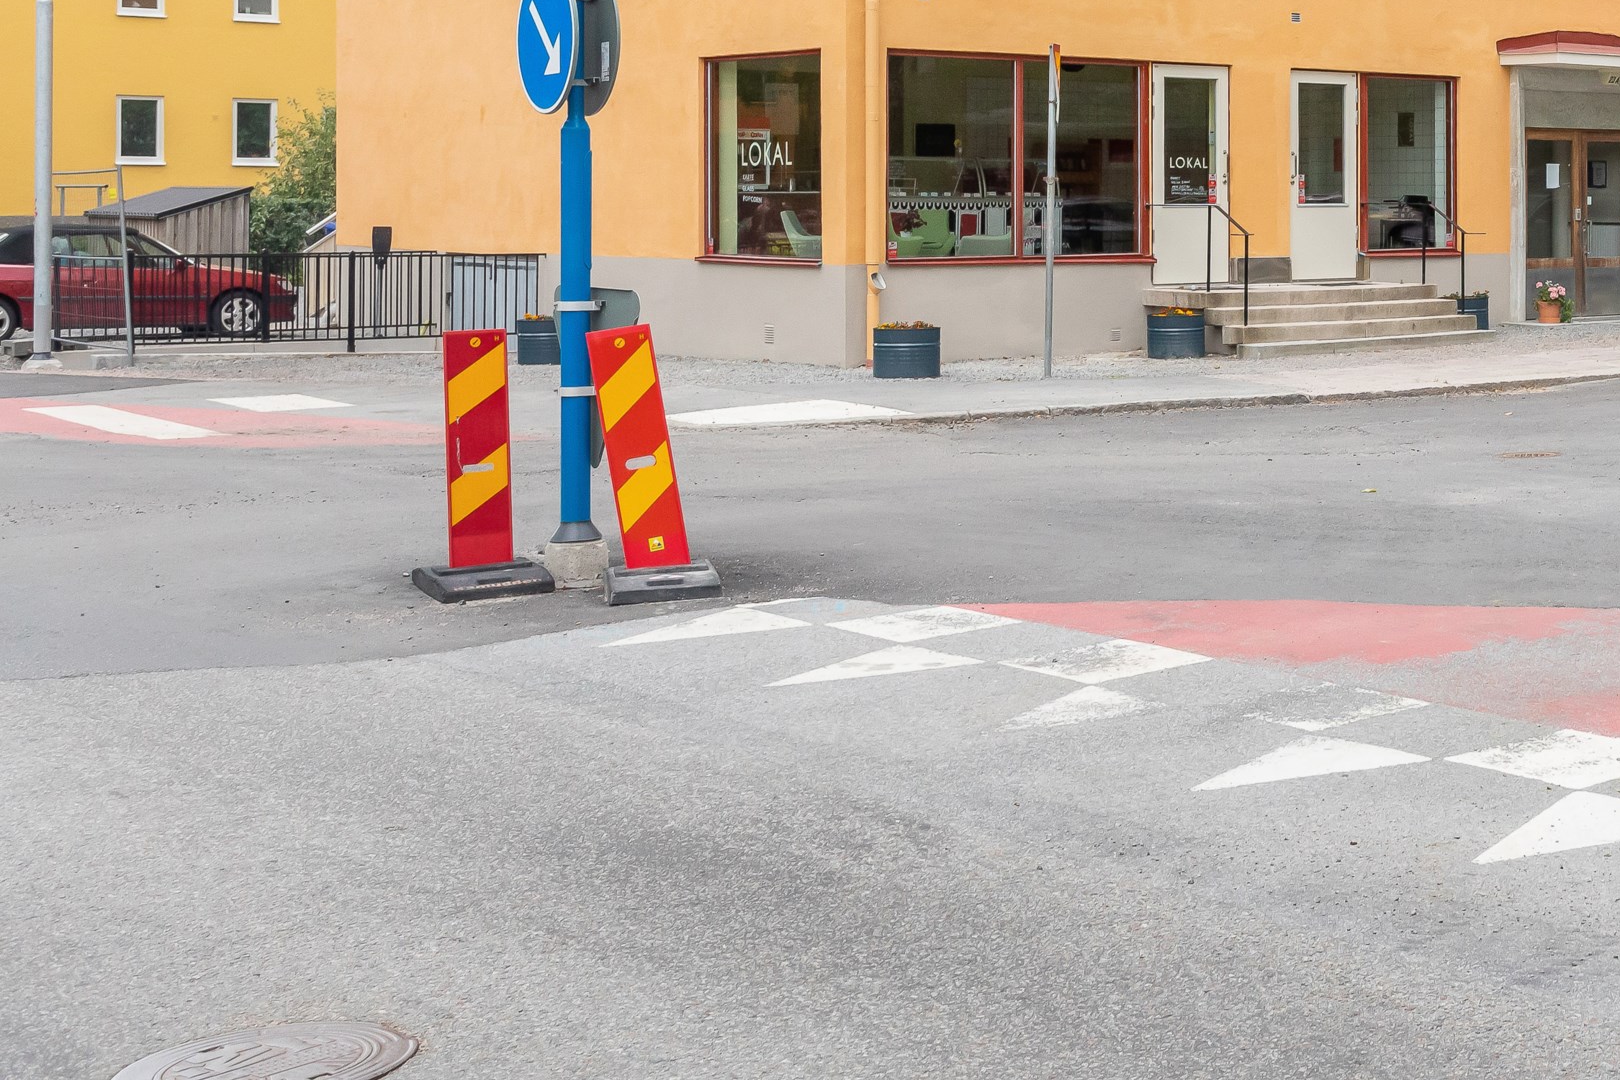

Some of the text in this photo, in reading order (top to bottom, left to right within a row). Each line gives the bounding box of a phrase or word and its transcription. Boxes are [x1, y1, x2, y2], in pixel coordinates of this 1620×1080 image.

[741, 141, 793, 166] LOKAL
[1169, 156, 1208, 169] LOKAL
[742, 195, 763, 204] POPCORN
